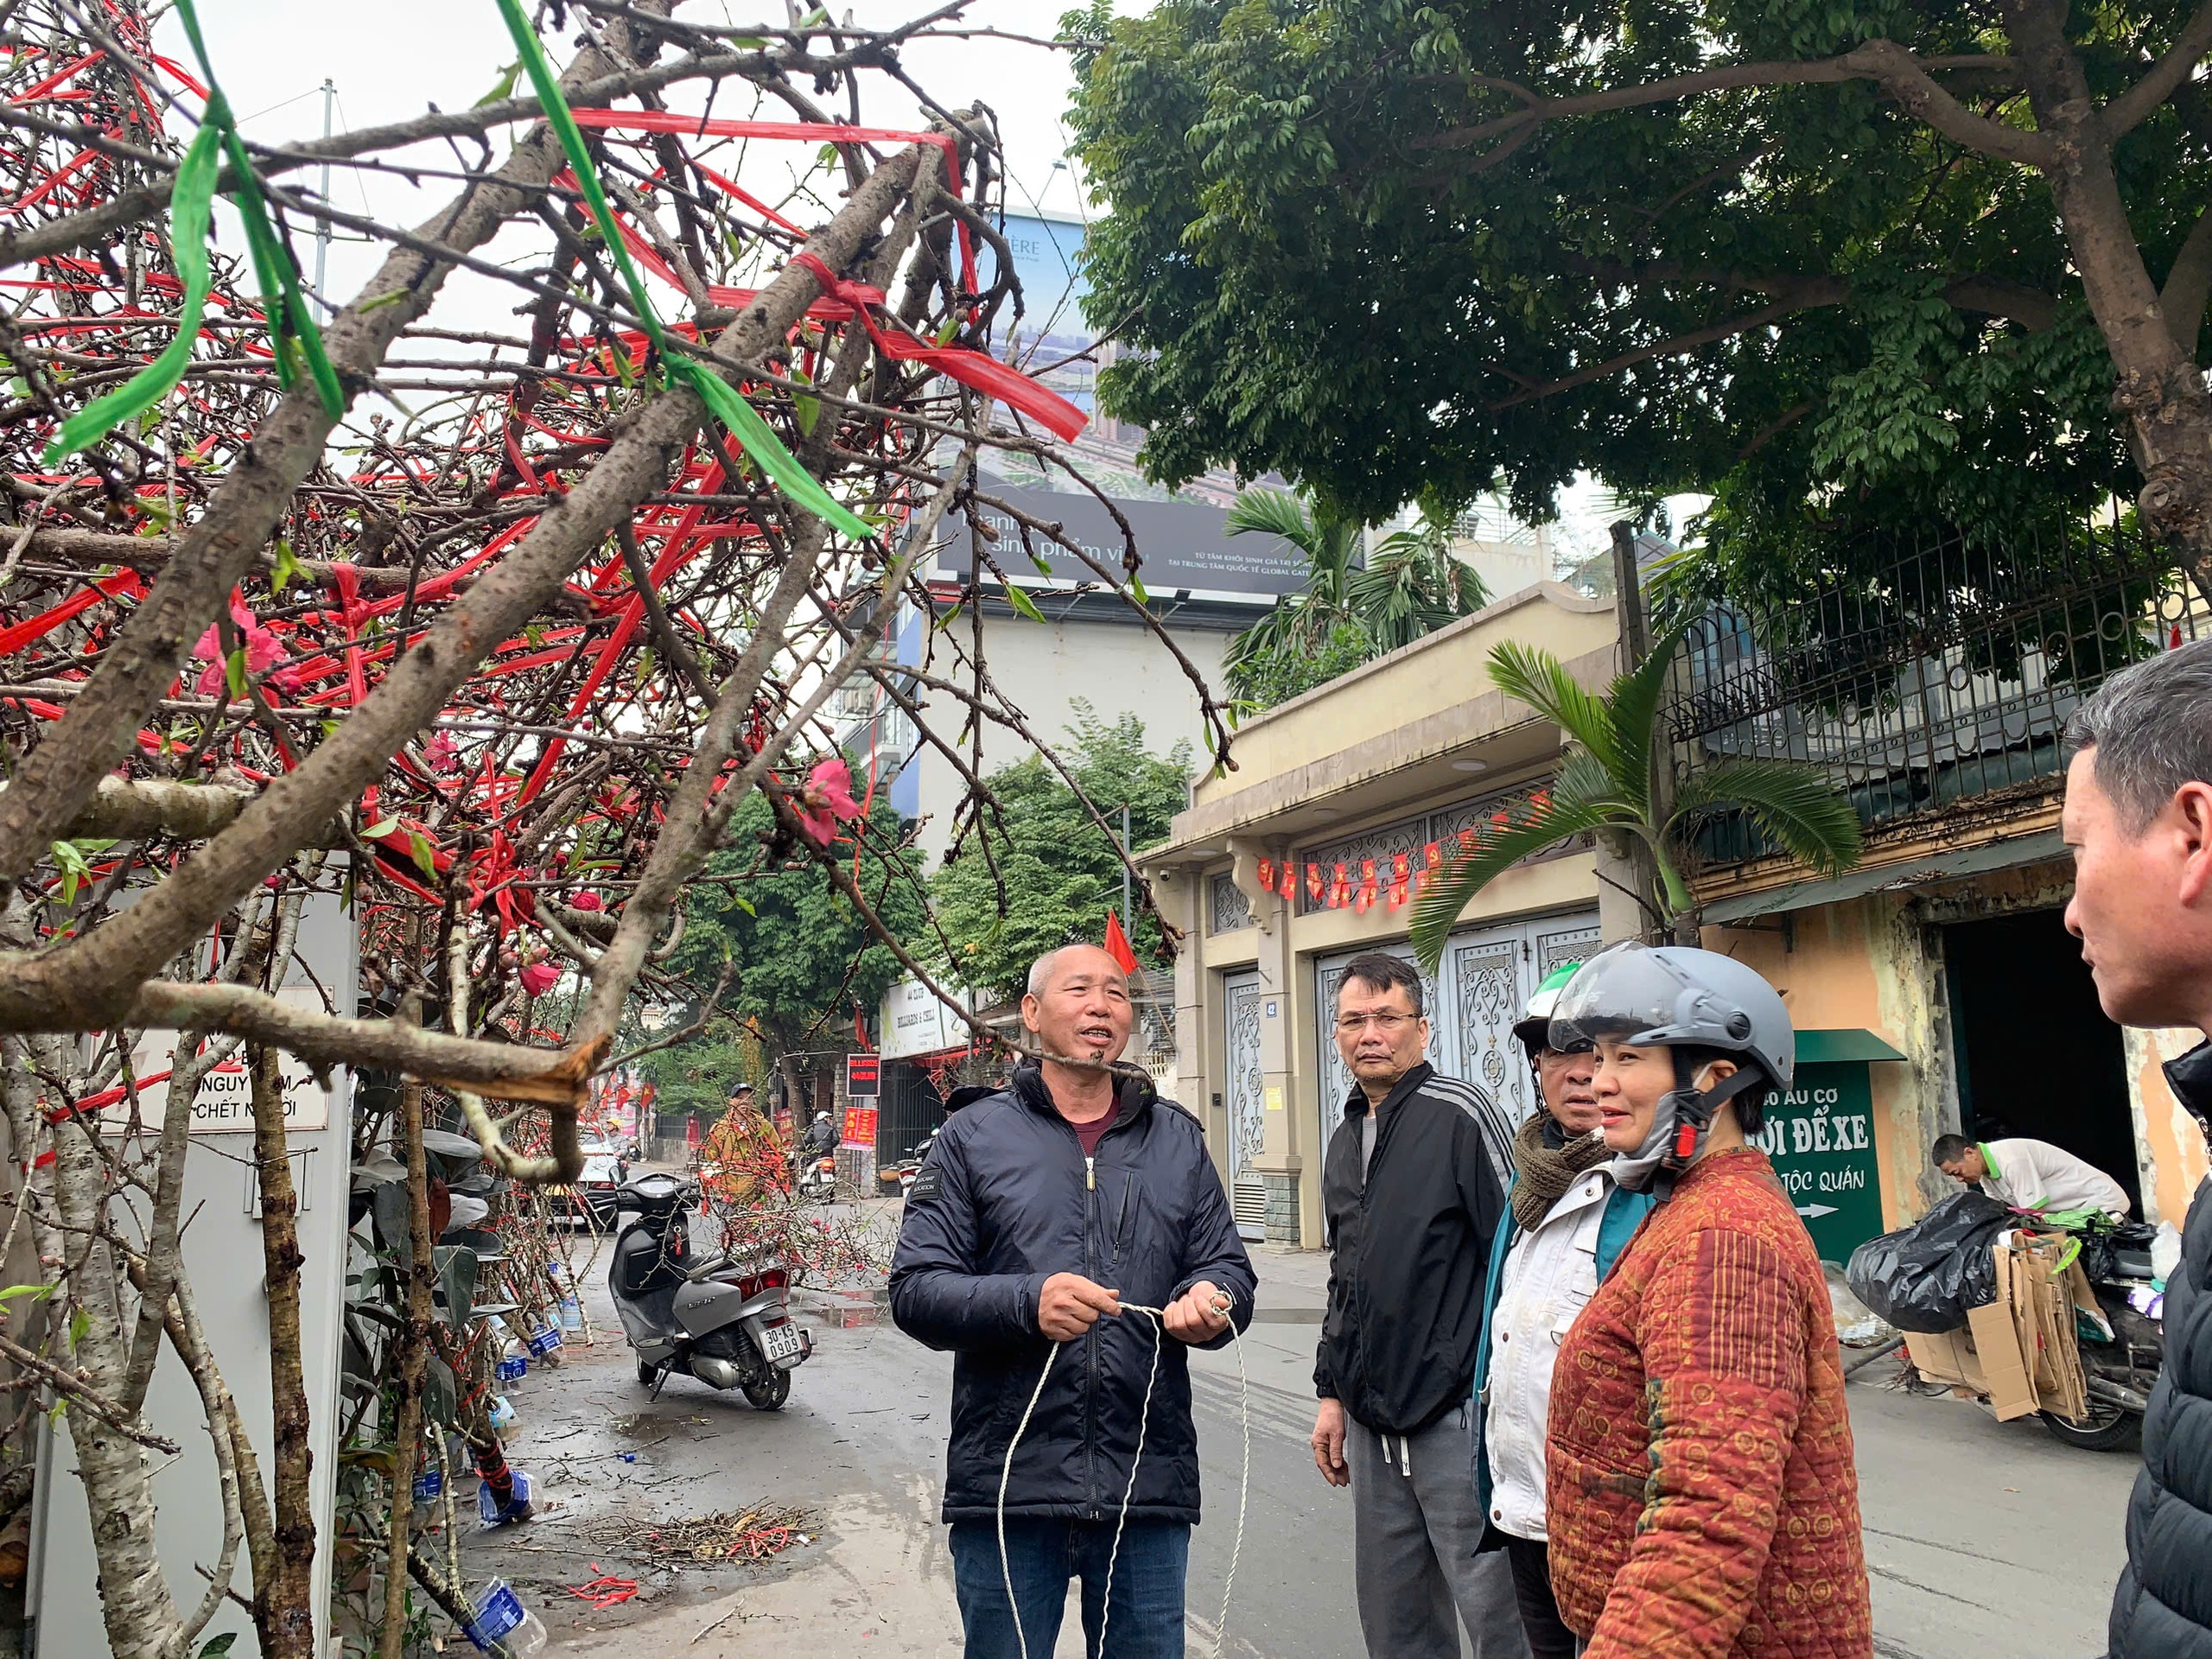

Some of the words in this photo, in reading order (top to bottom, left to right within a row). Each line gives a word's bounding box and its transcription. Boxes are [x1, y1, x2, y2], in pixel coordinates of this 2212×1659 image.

[958, 509, 1020, 531] Tanh
[1182, 559, 1208, 569] TRUNG
[1261, 567, 1289, 576] GLOBAL
[201, 1076, 248, 1092] NGUY
[1814, 1088, 1838, 1103] CƠ
[196, 1096, 239, 1119] CHẾT
[245, 1096, 296, 1117] NỜI
[1832, 1115, 1869, 1151] XE
[1819, 1165, 1865, 1192] QUÁN
[766, 1324, 794, 1344] 30-K5
[770, 1338, 799, 1358] 0909
